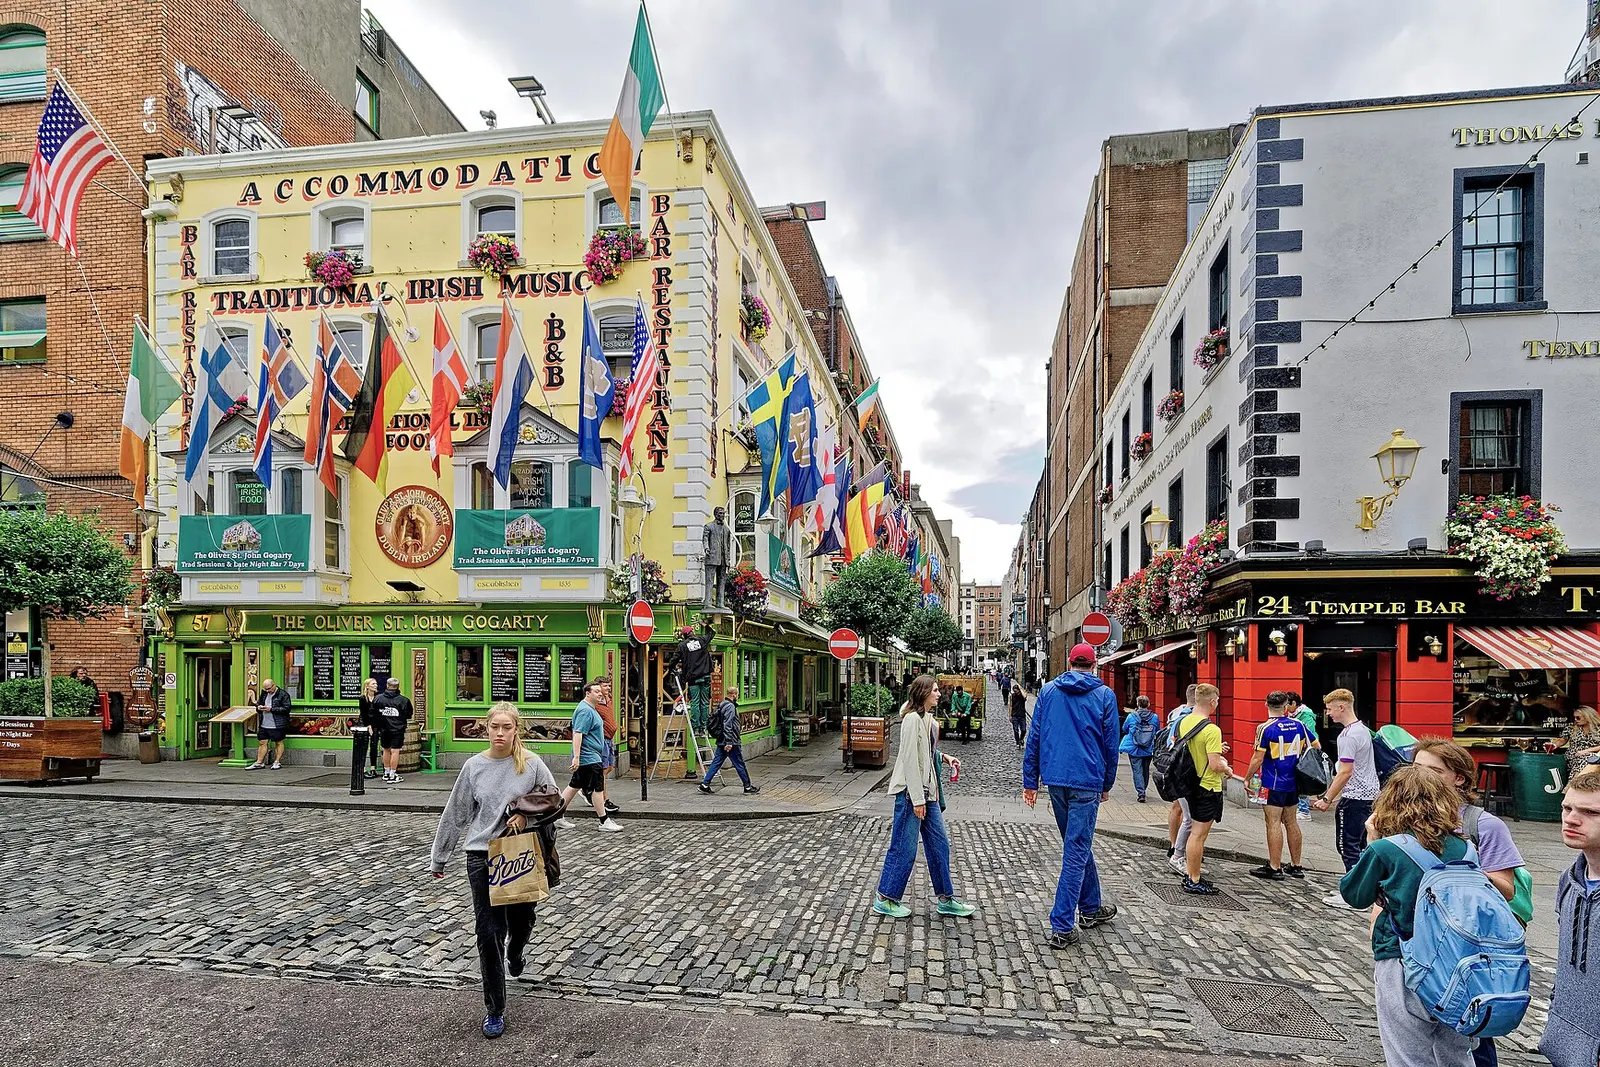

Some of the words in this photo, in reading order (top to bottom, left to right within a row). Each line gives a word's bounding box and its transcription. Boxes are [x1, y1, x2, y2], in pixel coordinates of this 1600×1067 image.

[1452, 121, 1584, 147] THOMAS
[237, 148, 643, 206] ACCOMMODATIO
[651, 194, 672, 260] BAR
[181, 225, 198, 280] BAR
[211, 281, 393, 315] TRADITIONAL
[405, 276, 484, 304] IRISH
[497, 270, 593, 299] MUSIC
[1522, 339, 1600, 360] TEM
[647, 266, 673, 473] RESTAURANT
[240, 488, 262, 496] IRISH
[240, 495, 263, 504] FOOD
[518, 487, 546, 496] MUSIC
[404, 489, 427, 499] JOHN
[426, 493, 451, 526] GOGARTY
[523, 498, 542, 507] BAR
[433, 512, 442, 527] BAR
[207, 551, 231, 559] Oliver
[243, 551, 262, 560] John
[262, 552, 293, 561] Gogarty
[378, 534, 409, 563] DUBLIN
[411, 534, 447, 564] IRELAND
[473, 547, 489, 555] The
[489, 547, 514, 555] Oliver
[527, 547, 547, 556] John
[548, 547, 580, 557] Gogarty
[249, 561, 269, 569] Night
[288, 561, 305, 569] Days
[475, 556, 508, 564] Sessions
[509, 556, 516, 564] &
[534, 556, 555, 565] Night
[576, 556, 595, 564] Days
[1235, 597, 1247, 618] 17
[1257, 595, 1293, 615] 24
[1305, 600, 1406, 615] TEMPLE
[1414, 600, 1467, 614] BAR
[1561, 586, 1600, 612] T
[192, 614, 212, 632] 57
[273, 615, 306, 632] THE
[314, 615, 375, 632] OLIVER
[383, 614, 408, 631] ST.
[411, 614, 452, 631] JOHN
[462, 614, 549, 632] GOGARTY
[1219, 608, 1235, 621] BAR
[1514, 679, 1540, 688] GUINNESS
[6, 741, 21, 749] Days
[1278, 733, 1301, 760] 14
[488, 849, 537, 887] Boots
